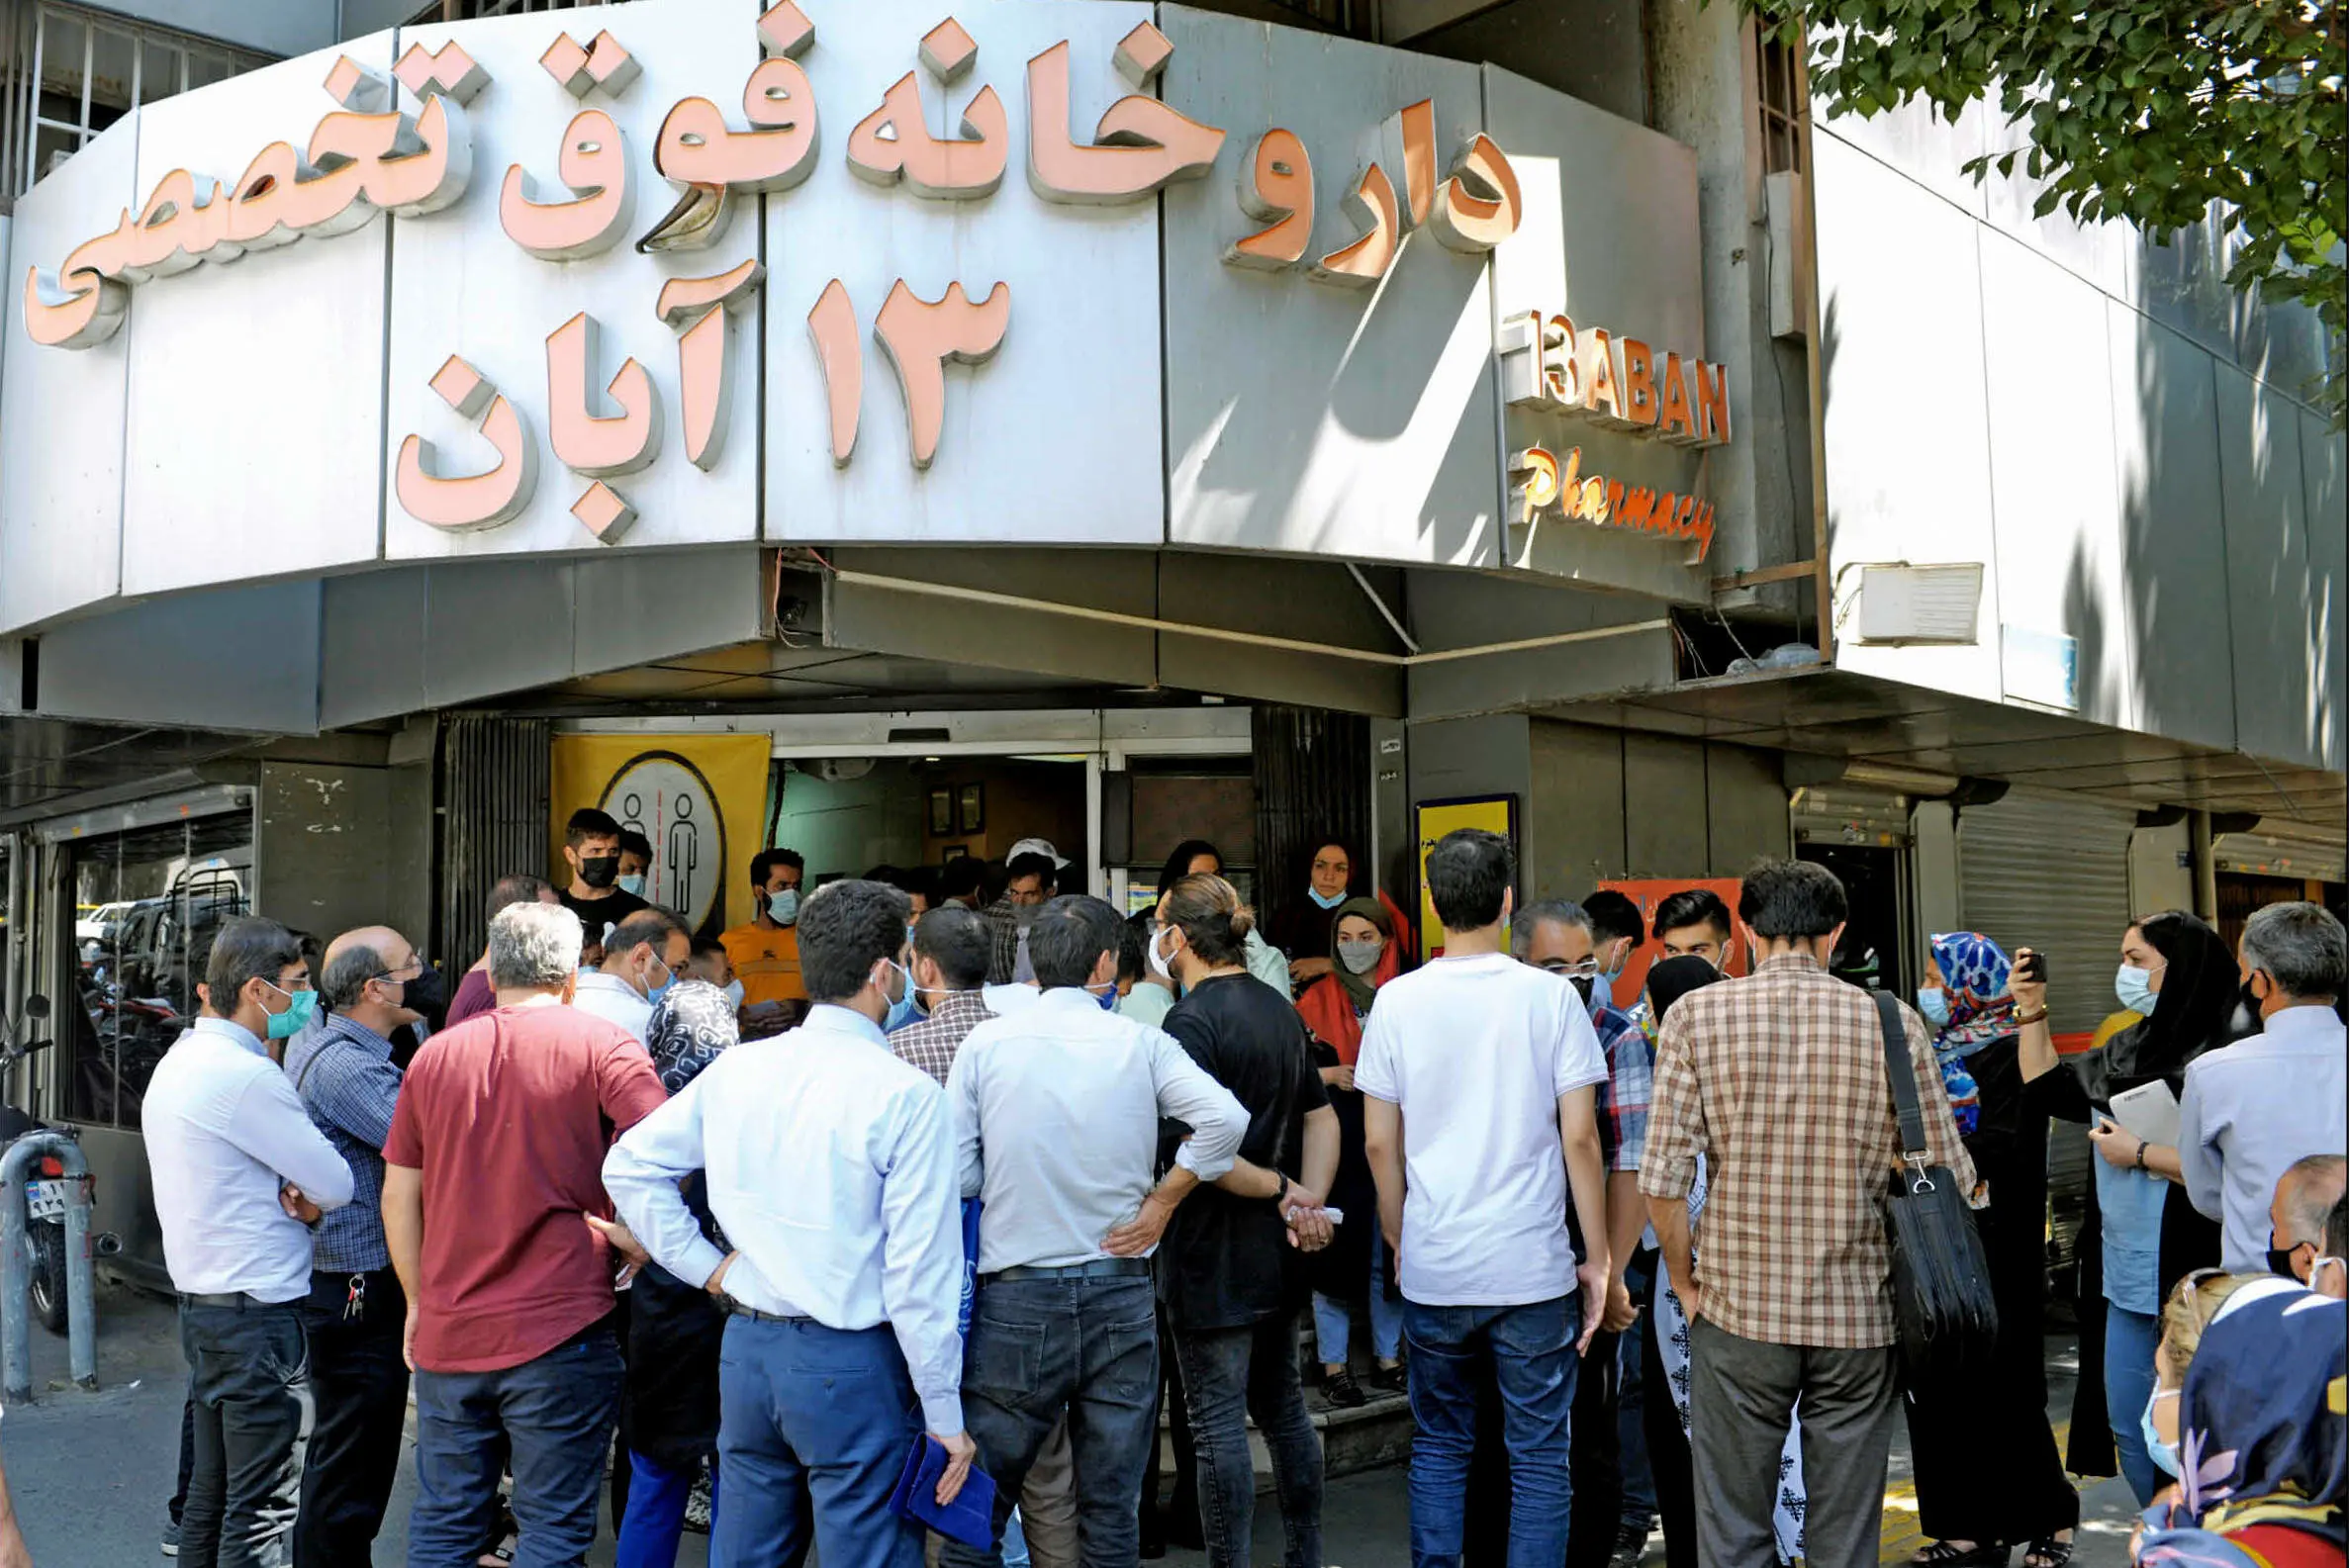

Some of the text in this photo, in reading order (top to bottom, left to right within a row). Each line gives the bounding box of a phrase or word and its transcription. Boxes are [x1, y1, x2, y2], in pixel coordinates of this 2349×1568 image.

[24, 40, 485, 348] تخصصی
[500, 0, 819, 260] فوق
[396, 258, 1010, 542] ۱۳ آبان
[1519, 445, 1717, 564] Pharmacy
